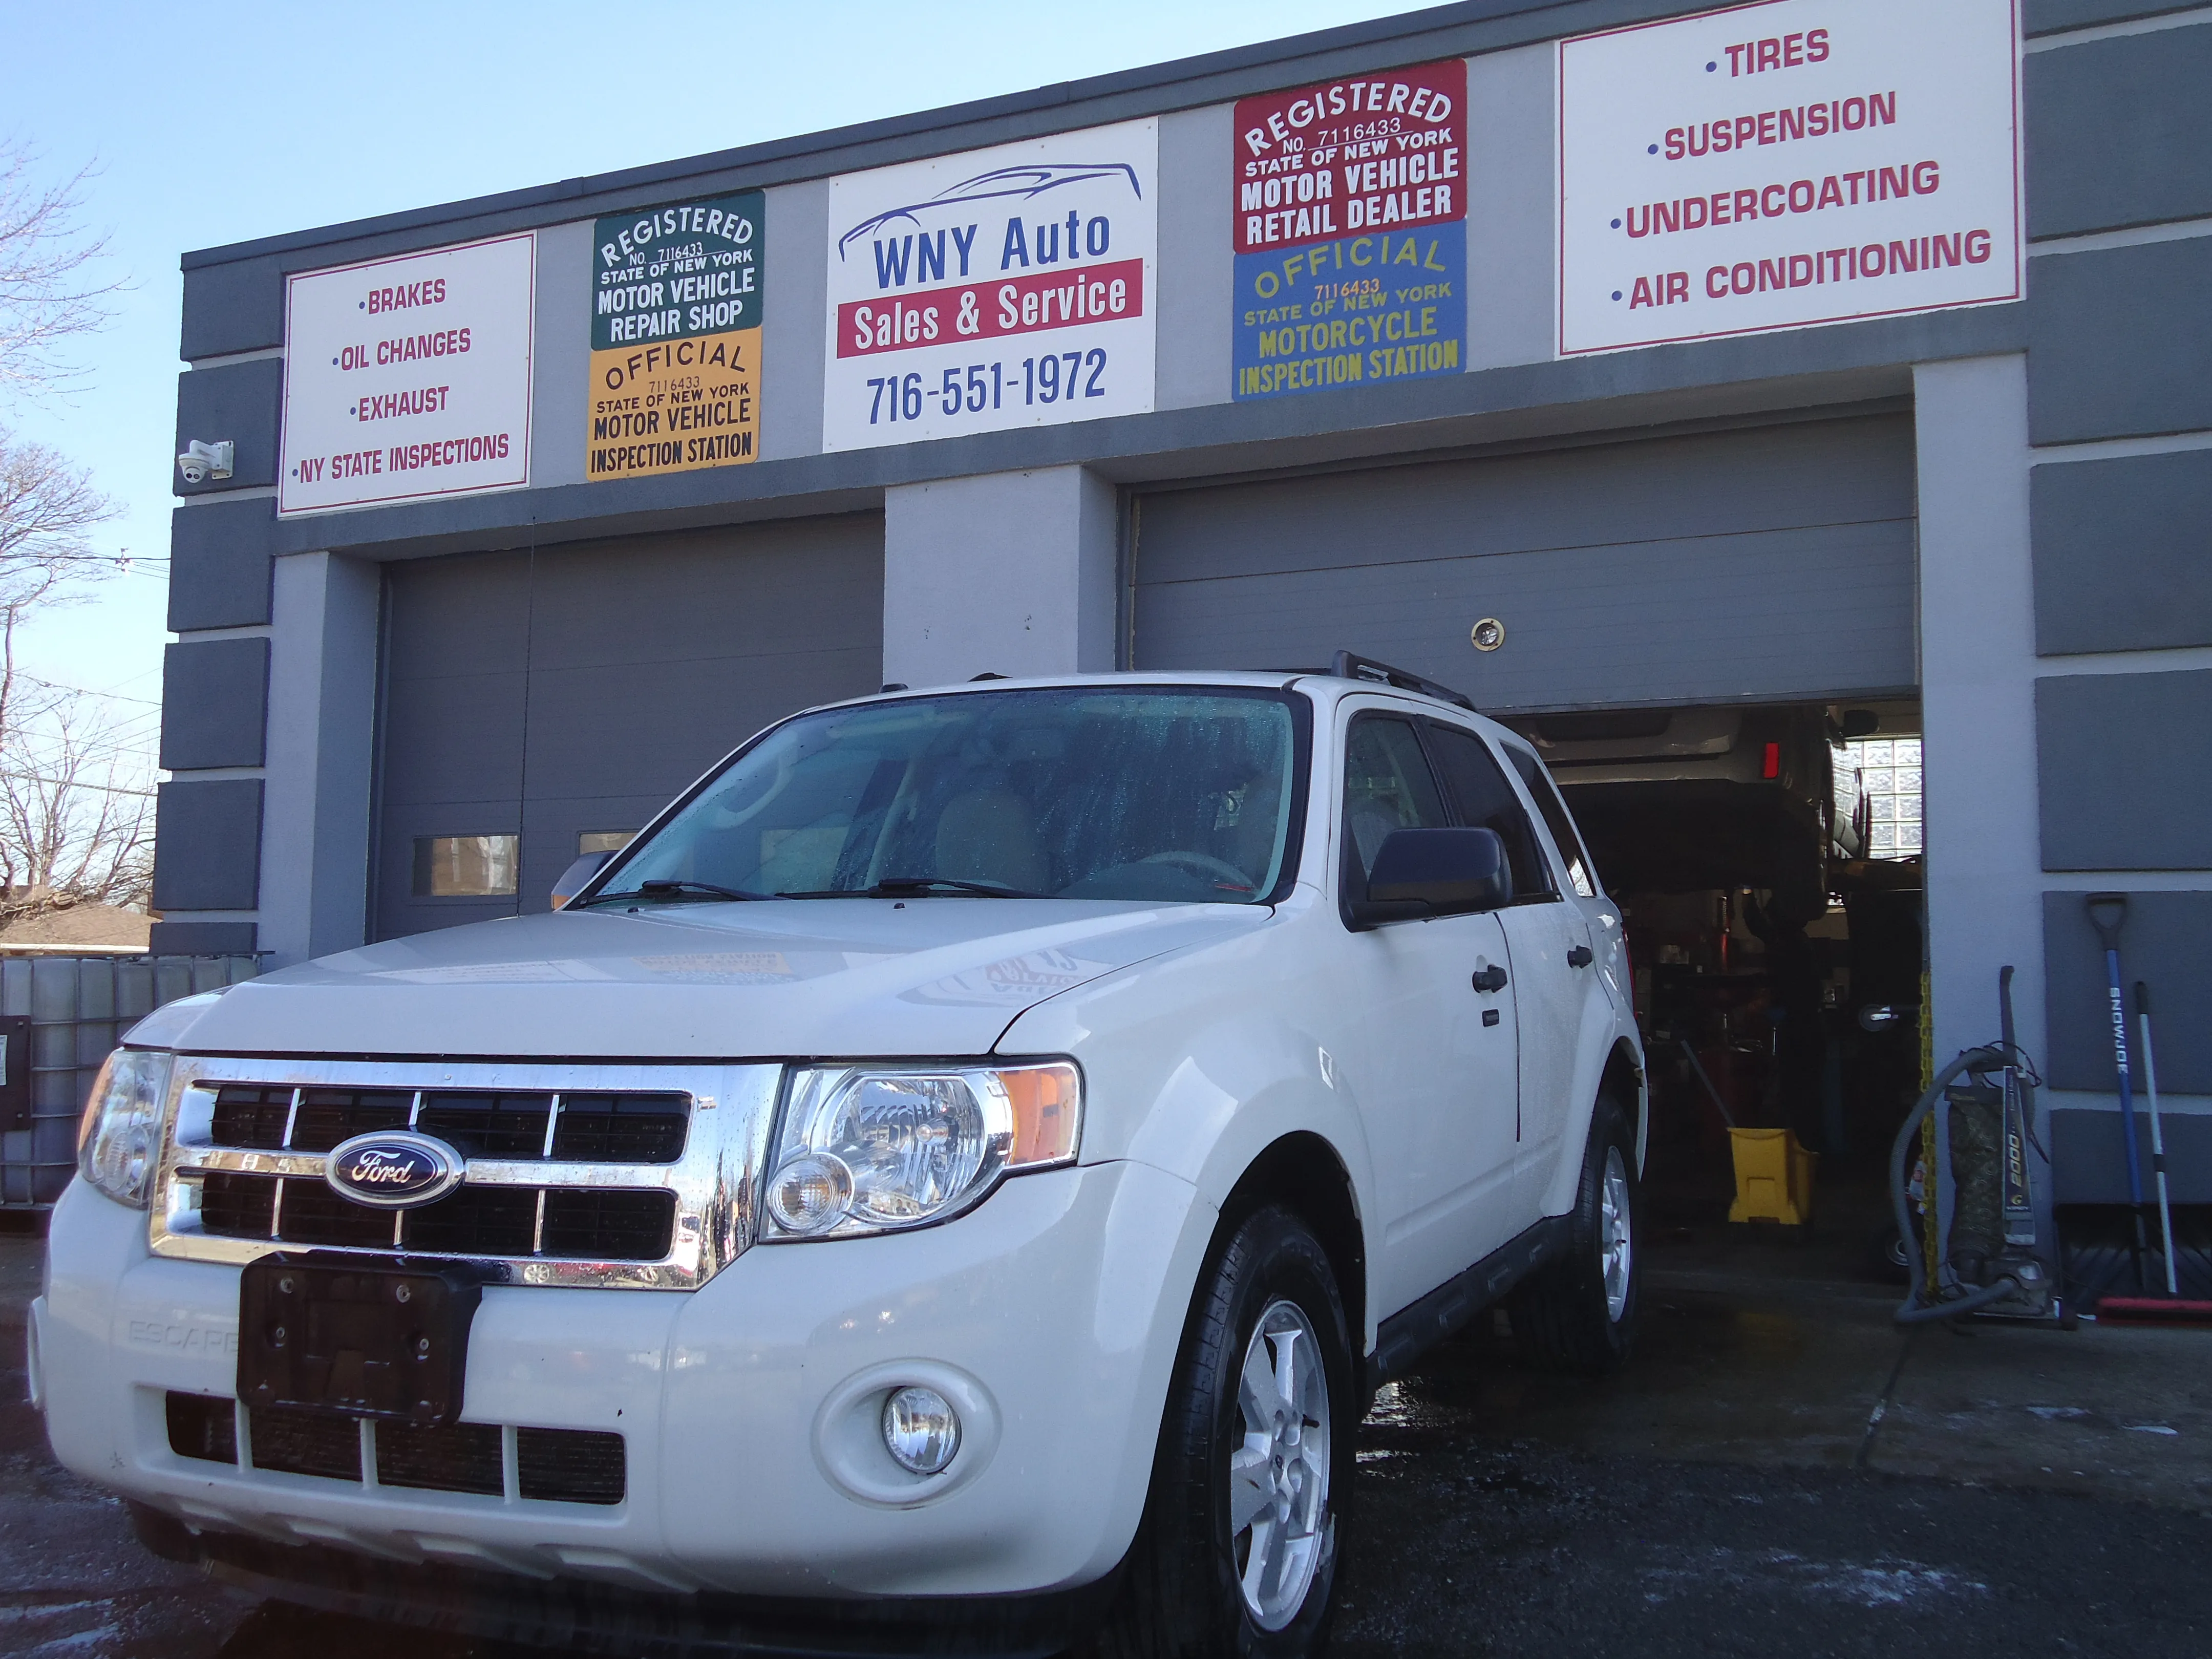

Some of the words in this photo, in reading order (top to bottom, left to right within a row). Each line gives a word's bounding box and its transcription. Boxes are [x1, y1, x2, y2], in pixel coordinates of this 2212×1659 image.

[1725, 28, 1830, 78] TIRES
[1244, 82, 1452, 157] REGISTERED
[1283, 137, 1306, 154] NO.
[1318, 117, 1401, 147] 7116433
[1665, 91, 1897, 161] SUSPENSION
[1245, 156, 1304, 177] STATE
[1311, 148, 1336, 167] OF
[1345, 139, 1388, 161] NEW
[1396, 127, 1453, 151] YORK
[1241, 169, 1332, 211] MOTOR
[1345, 148, 1459, 194] VEHICLE
[1626, 160, 1940, 239] UNDERCOATING
[601, 207, 754, 268] REGISTERED
[1247, 204, 1337, 245] RETAIL
[1348, 184, 1452, 229] DEALER
[601, 267, 644, 285] STATE
[650, 263, 668, 278] OF
[674, 255, 707, 274] NEW
[712, 248, 753, 267] YORK
[629, 251, 647, 266] NO.
[657, 242, 704, 262] 7116433
[874, 224, 978, 290] WNY
[1001, 209, 1110, 271] Auto
[1254, 236, 1447, 299] OFFICIAL
[1629, 270, 1689, 310] AIR
[1706, 229, 1992, 299] CONDITIONING
[368, 278, 446, 314] BRAKES
[598, 282, 664, 315] MOTOR
[670, 267, 755, 304] VEHICLE
[855, 302, 940, 349] Sales
[956, 291, 980, 335] &
[998, 274, 1126, 329] Service
[1244, 305, 1302, 326] STATE
[1310, 299, 1337, 316] OF
[1344, 290, 1388, 311] NEW
[1396, 283, 1453, 304] YORK
[1314, 278, 1381, 300] 7116433
[610, 309, 680, 342] REPAIR
[688, 300, 743, 331] SHOP
[1259, 306, 1438, 358] MOTORCYCLE
[341, 345, 369, 371] OIL
[377, 328, 471, 365] CHANGES
[606, 341, 746, 390] OFFICIAL
[1239, 352, 1363, 395] INSPECTION
[1369, 339, 1459, 379] STATION
[358, 386, 449, 422] EXHAUST
[597, 397, 640, 413] STATE
[646, 393, 665, 408] OF
[671, 387, 703, 405] NEW
[709, 382, 750, 399] YORK
[649, 376, 700, 393] 7116433
[867, 348, 1107, 425] 716-551-1972
[594, 410, 660, 441] MOTOR
[667, 398, 751, 431] VEHICLE
[300, 457, 325, 483] NY
[331, 449, 382, 479] STATE
[389, 433, 509, 472] INSPECTIONS
[591, 440, 683, 473] INSPECTION
[687, 432, 752, 462] STATION
[352, 1150, 415, 1184] Ford
